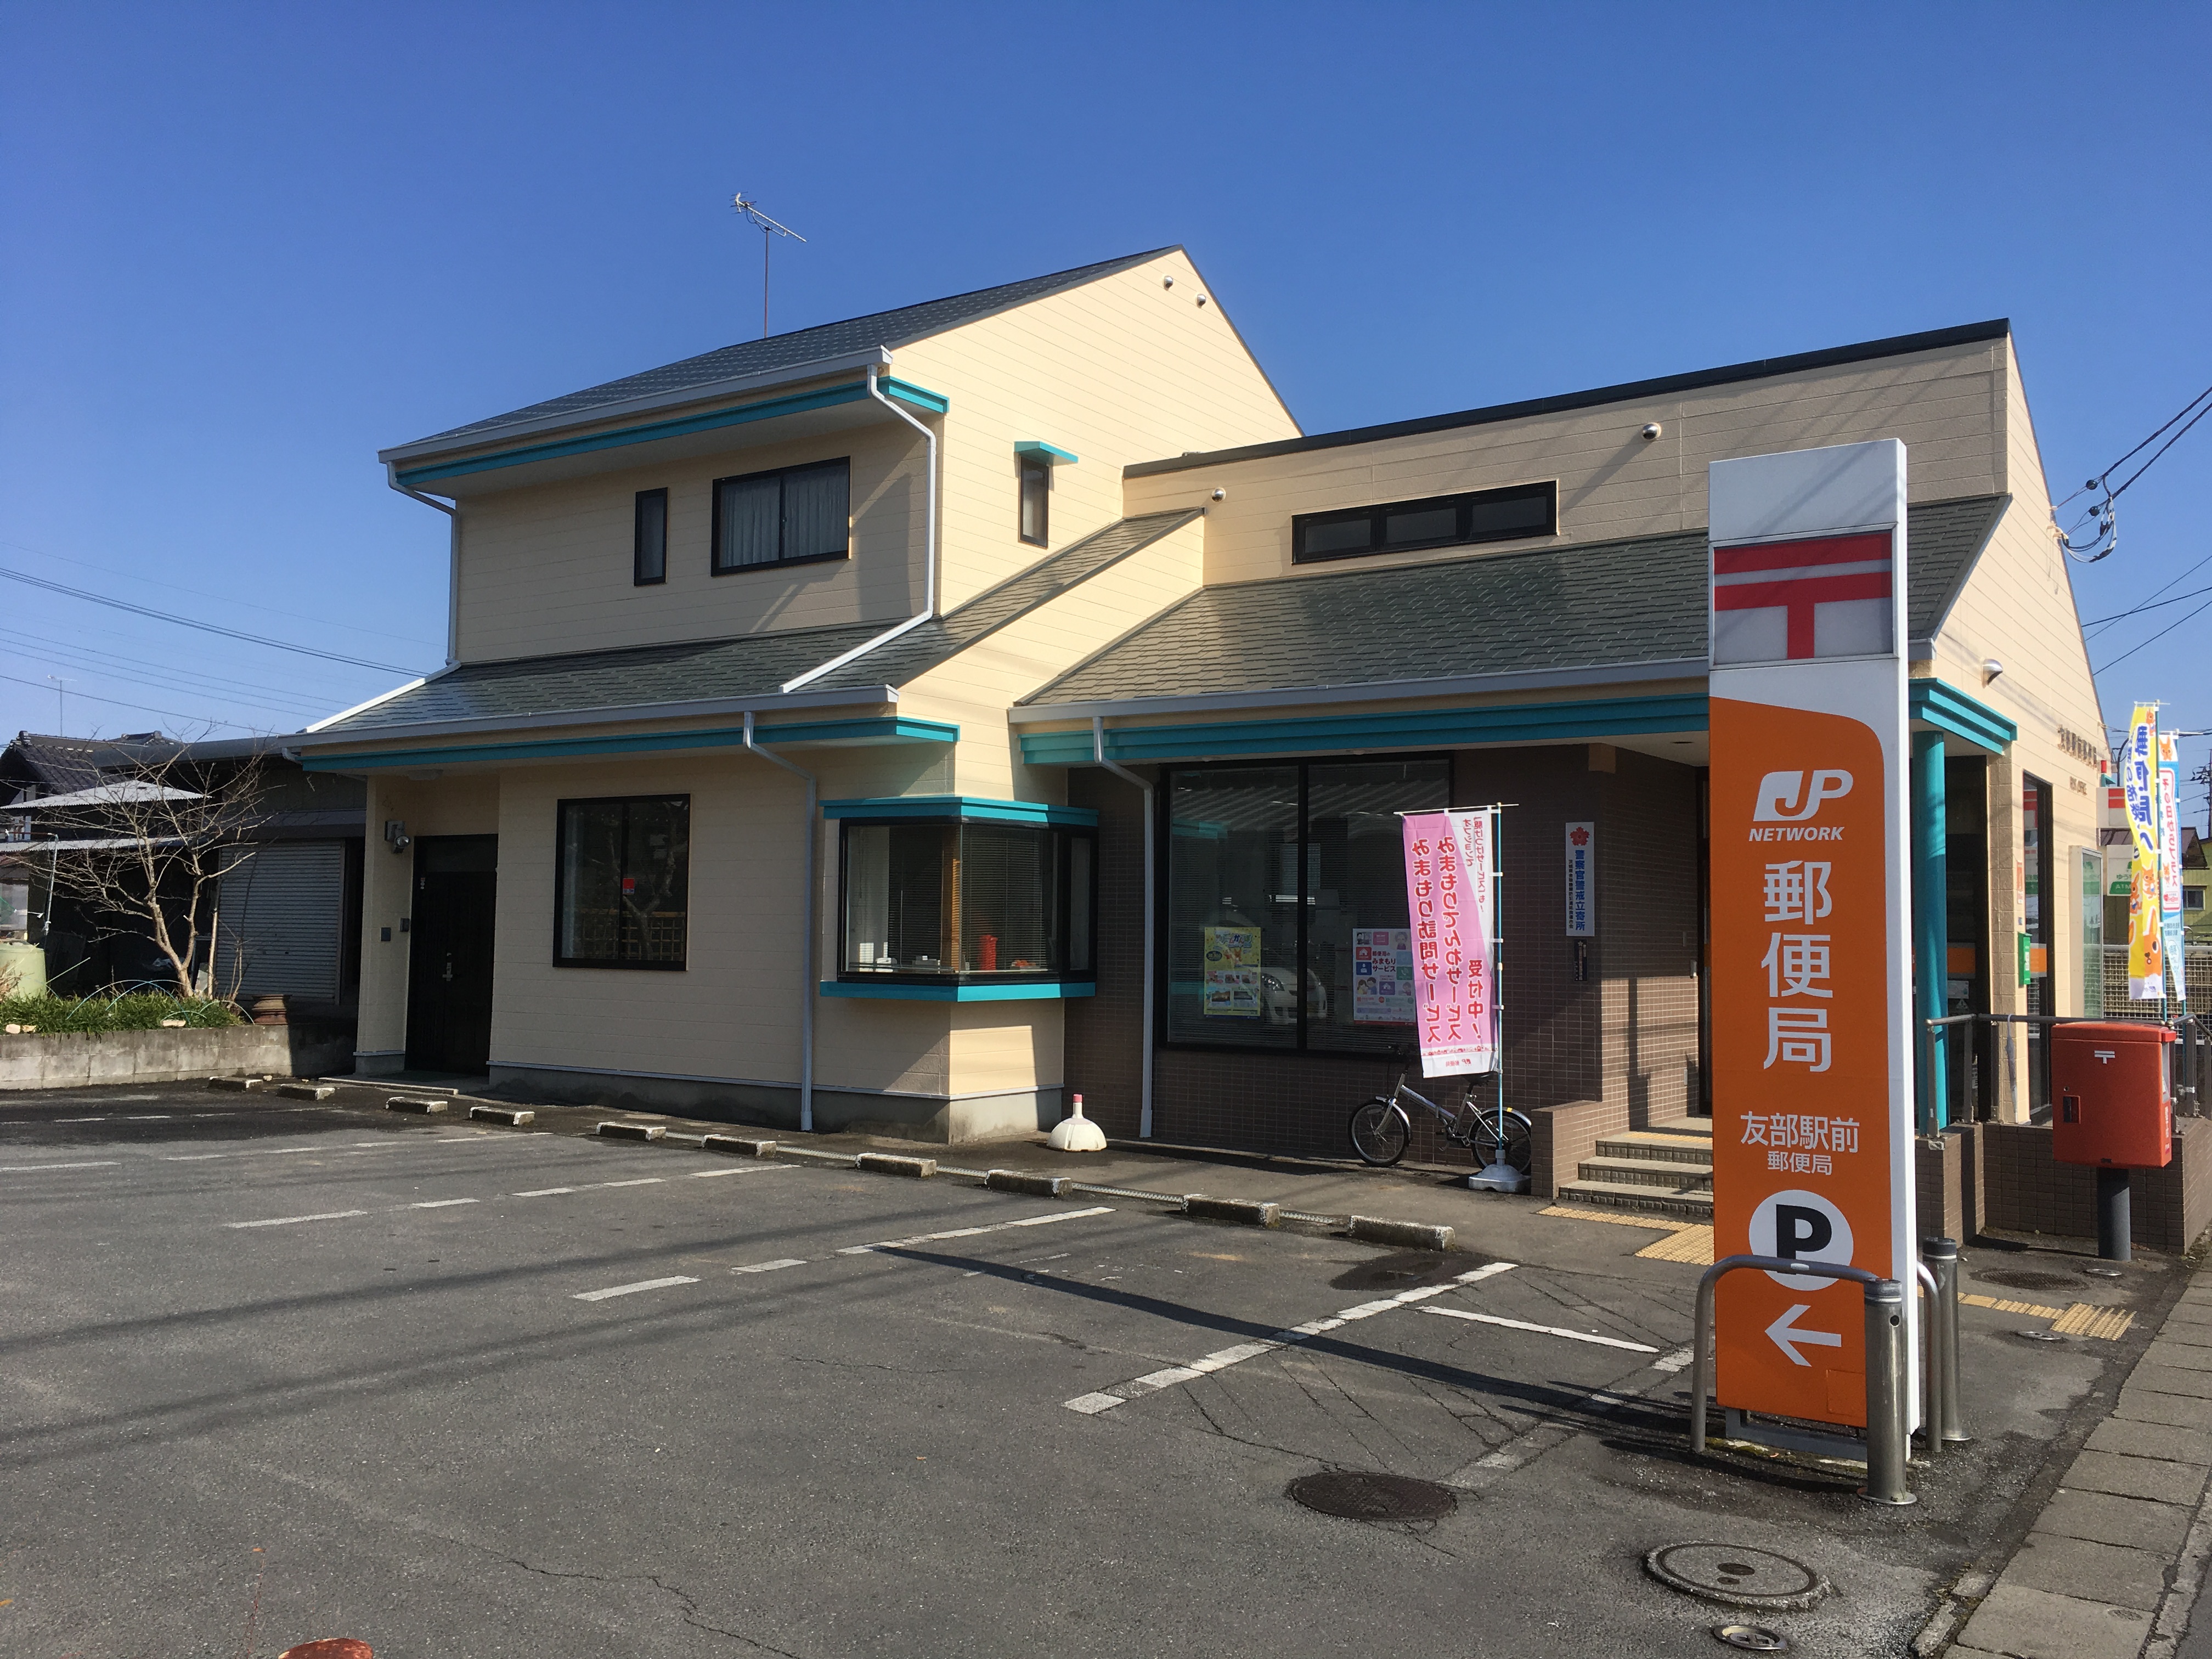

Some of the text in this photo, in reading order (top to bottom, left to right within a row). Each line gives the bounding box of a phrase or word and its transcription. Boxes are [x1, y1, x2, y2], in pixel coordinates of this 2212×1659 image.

[1753, 769, 1854, 822] JP
[1749, 827, 1844, 842] NETWORK
[1575, 850, 1585, 931] 警察官警戒立寄所
[1761, 860, 1833, 1072] 郵便局
[1740, 1111, 1860, 1153] 友部駅前
[1767, 1150, 1832, 1175] 郵便局
[1775, 1204, 1832, 1275] P
